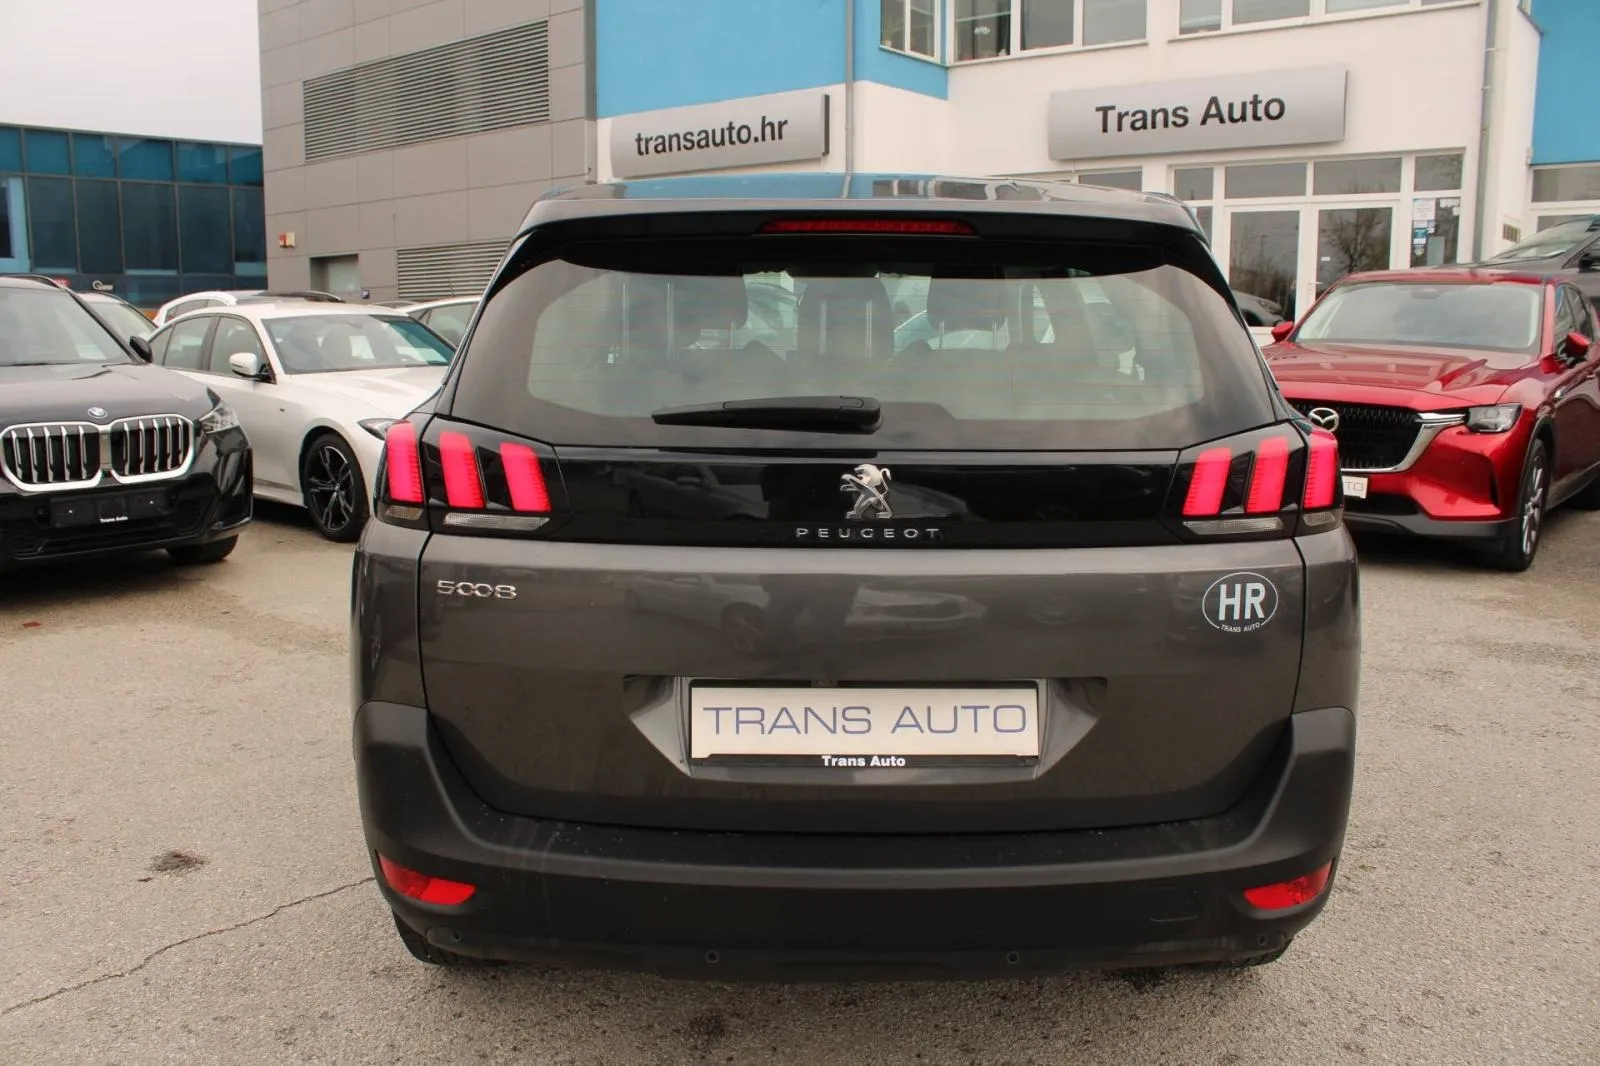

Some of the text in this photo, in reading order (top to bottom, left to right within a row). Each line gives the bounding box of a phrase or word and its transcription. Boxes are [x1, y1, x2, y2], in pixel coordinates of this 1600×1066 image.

[1095, 94, 1286, 133] Trans Auto
[635, 115, 788, 156] transauto.hr
[796, 528, 939, 538] PEUGEOT
[437, 580, 517, 599] 5008
[1218, 583, 1266, 620] HR
[1221, 622, 1260, 632] TRANS AUTO
[703, 705, 1026, 734] TRANS AUTO
[822, 755, 906, 767] Trans Auto
